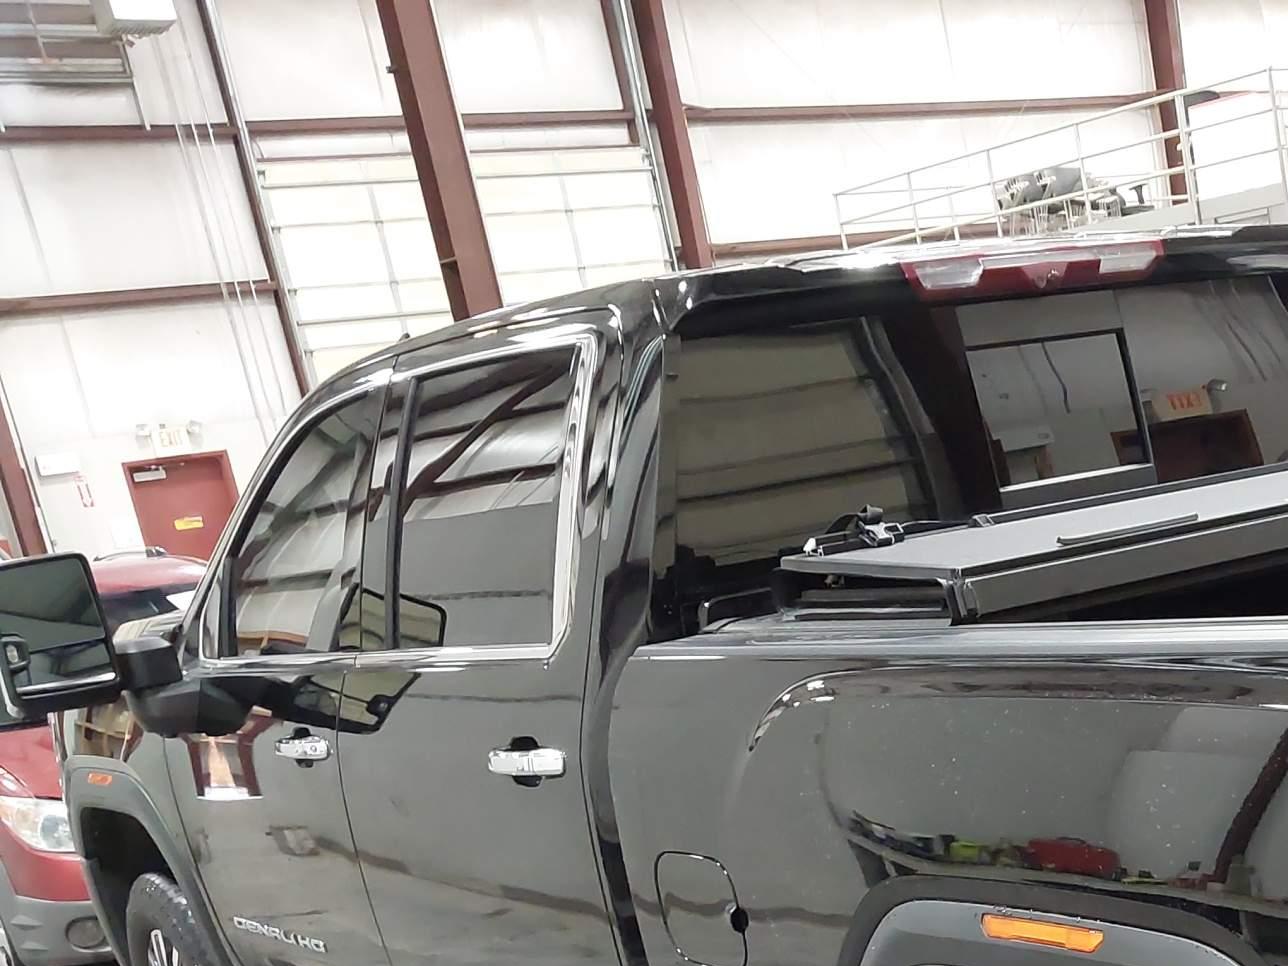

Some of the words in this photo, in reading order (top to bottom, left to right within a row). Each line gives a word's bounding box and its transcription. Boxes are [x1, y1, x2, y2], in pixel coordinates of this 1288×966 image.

[158, 427, 184, 448] EXIT
[233, 915, 297, 946] DENALI
[296, 933, 327, 953] HD
